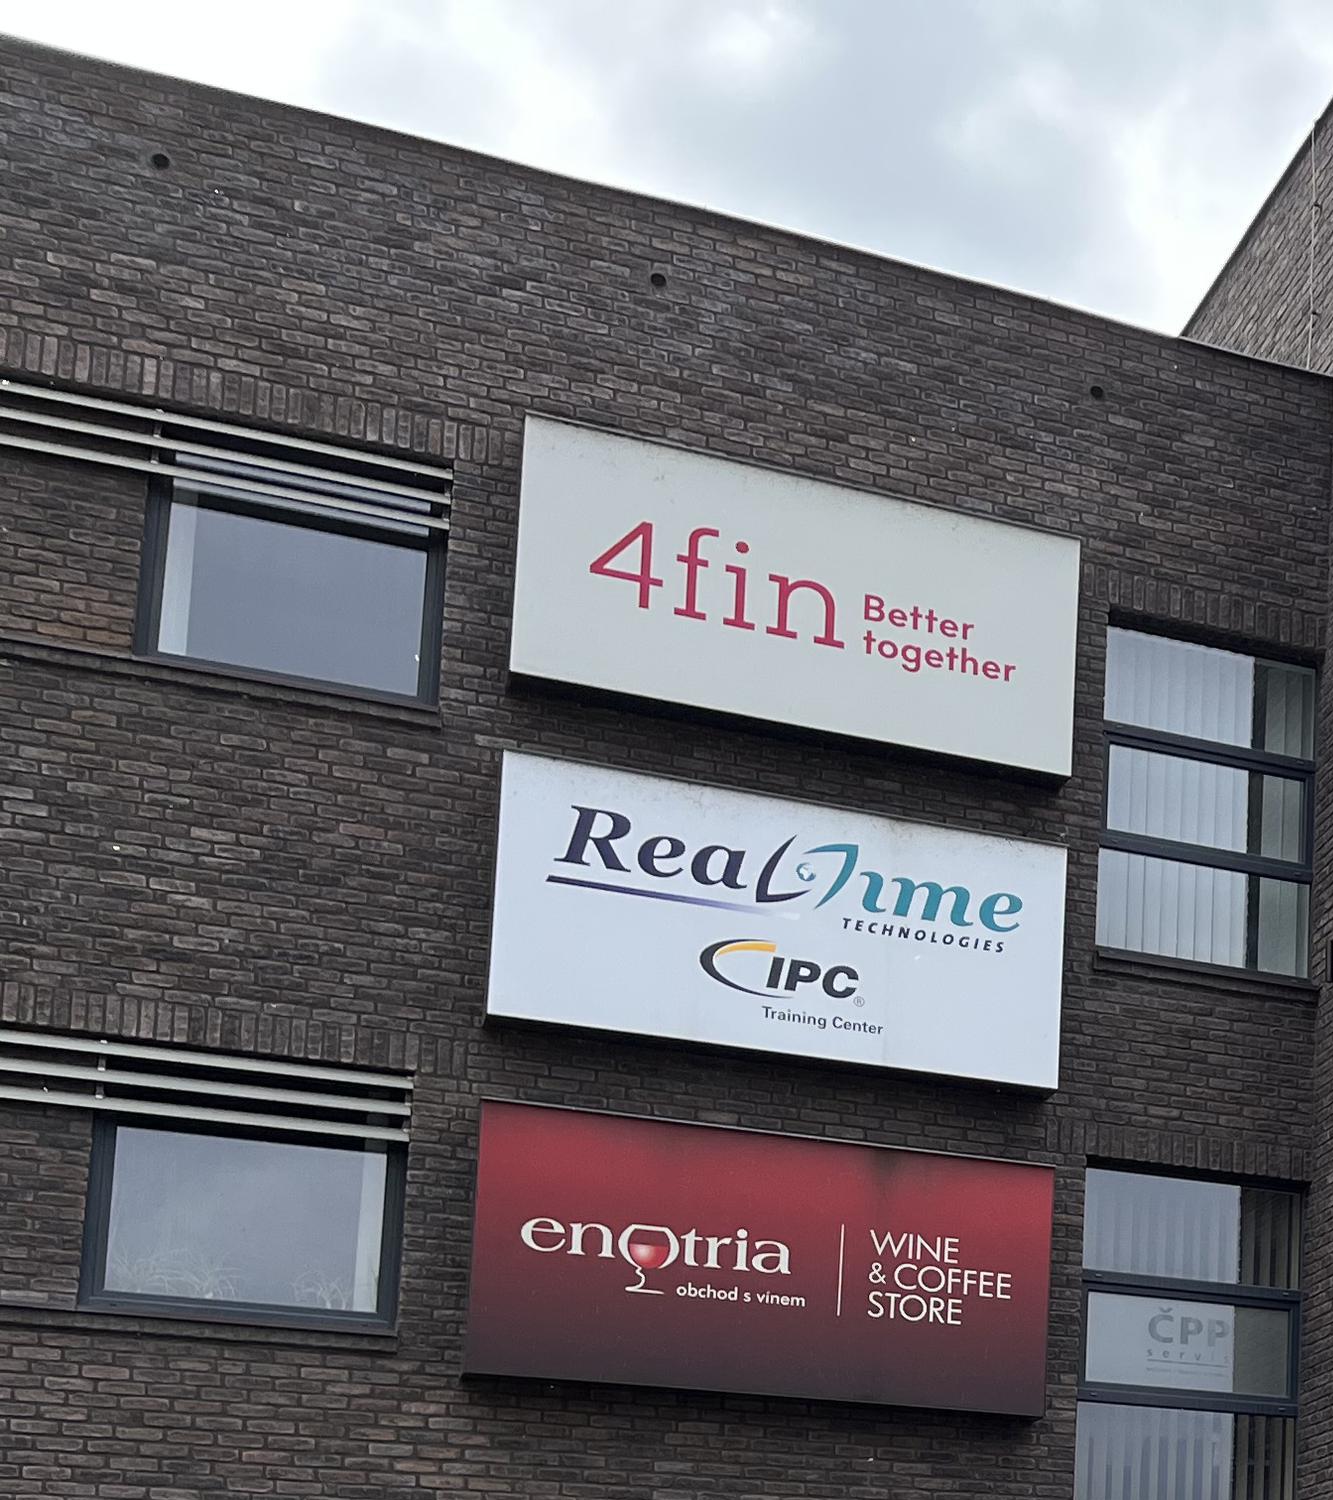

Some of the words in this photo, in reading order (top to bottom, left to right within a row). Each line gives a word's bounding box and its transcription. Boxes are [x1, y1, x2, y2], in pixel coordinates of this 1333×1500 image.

[588, 520, 846, 650] 4fin
[863, 594, 976, 641] Better
[862, 630, 1017, 684] together
[841, 917, 1006, 954] TECHNOLOGIES
[764, 953, 861, 1001] IPC
[762, 1005, 827, 1031] Training
[831, 1015, 885, 1037] Center
[519, 1215, 792, 1286] enotria
[869, 1227, 960, 1265] WINE
[675, 1281, 739, 1304] obchod
[743, 1288, 752, 1303] s
[754, 1286, 806, 1308] vínem
[867, 1262, 887, 1285] &
[893, 1264, 1013, 1300] COFFEE
[867, 1291, 963, 1326] STORE
[1148, 1306, 1231, 1348] ČPP
